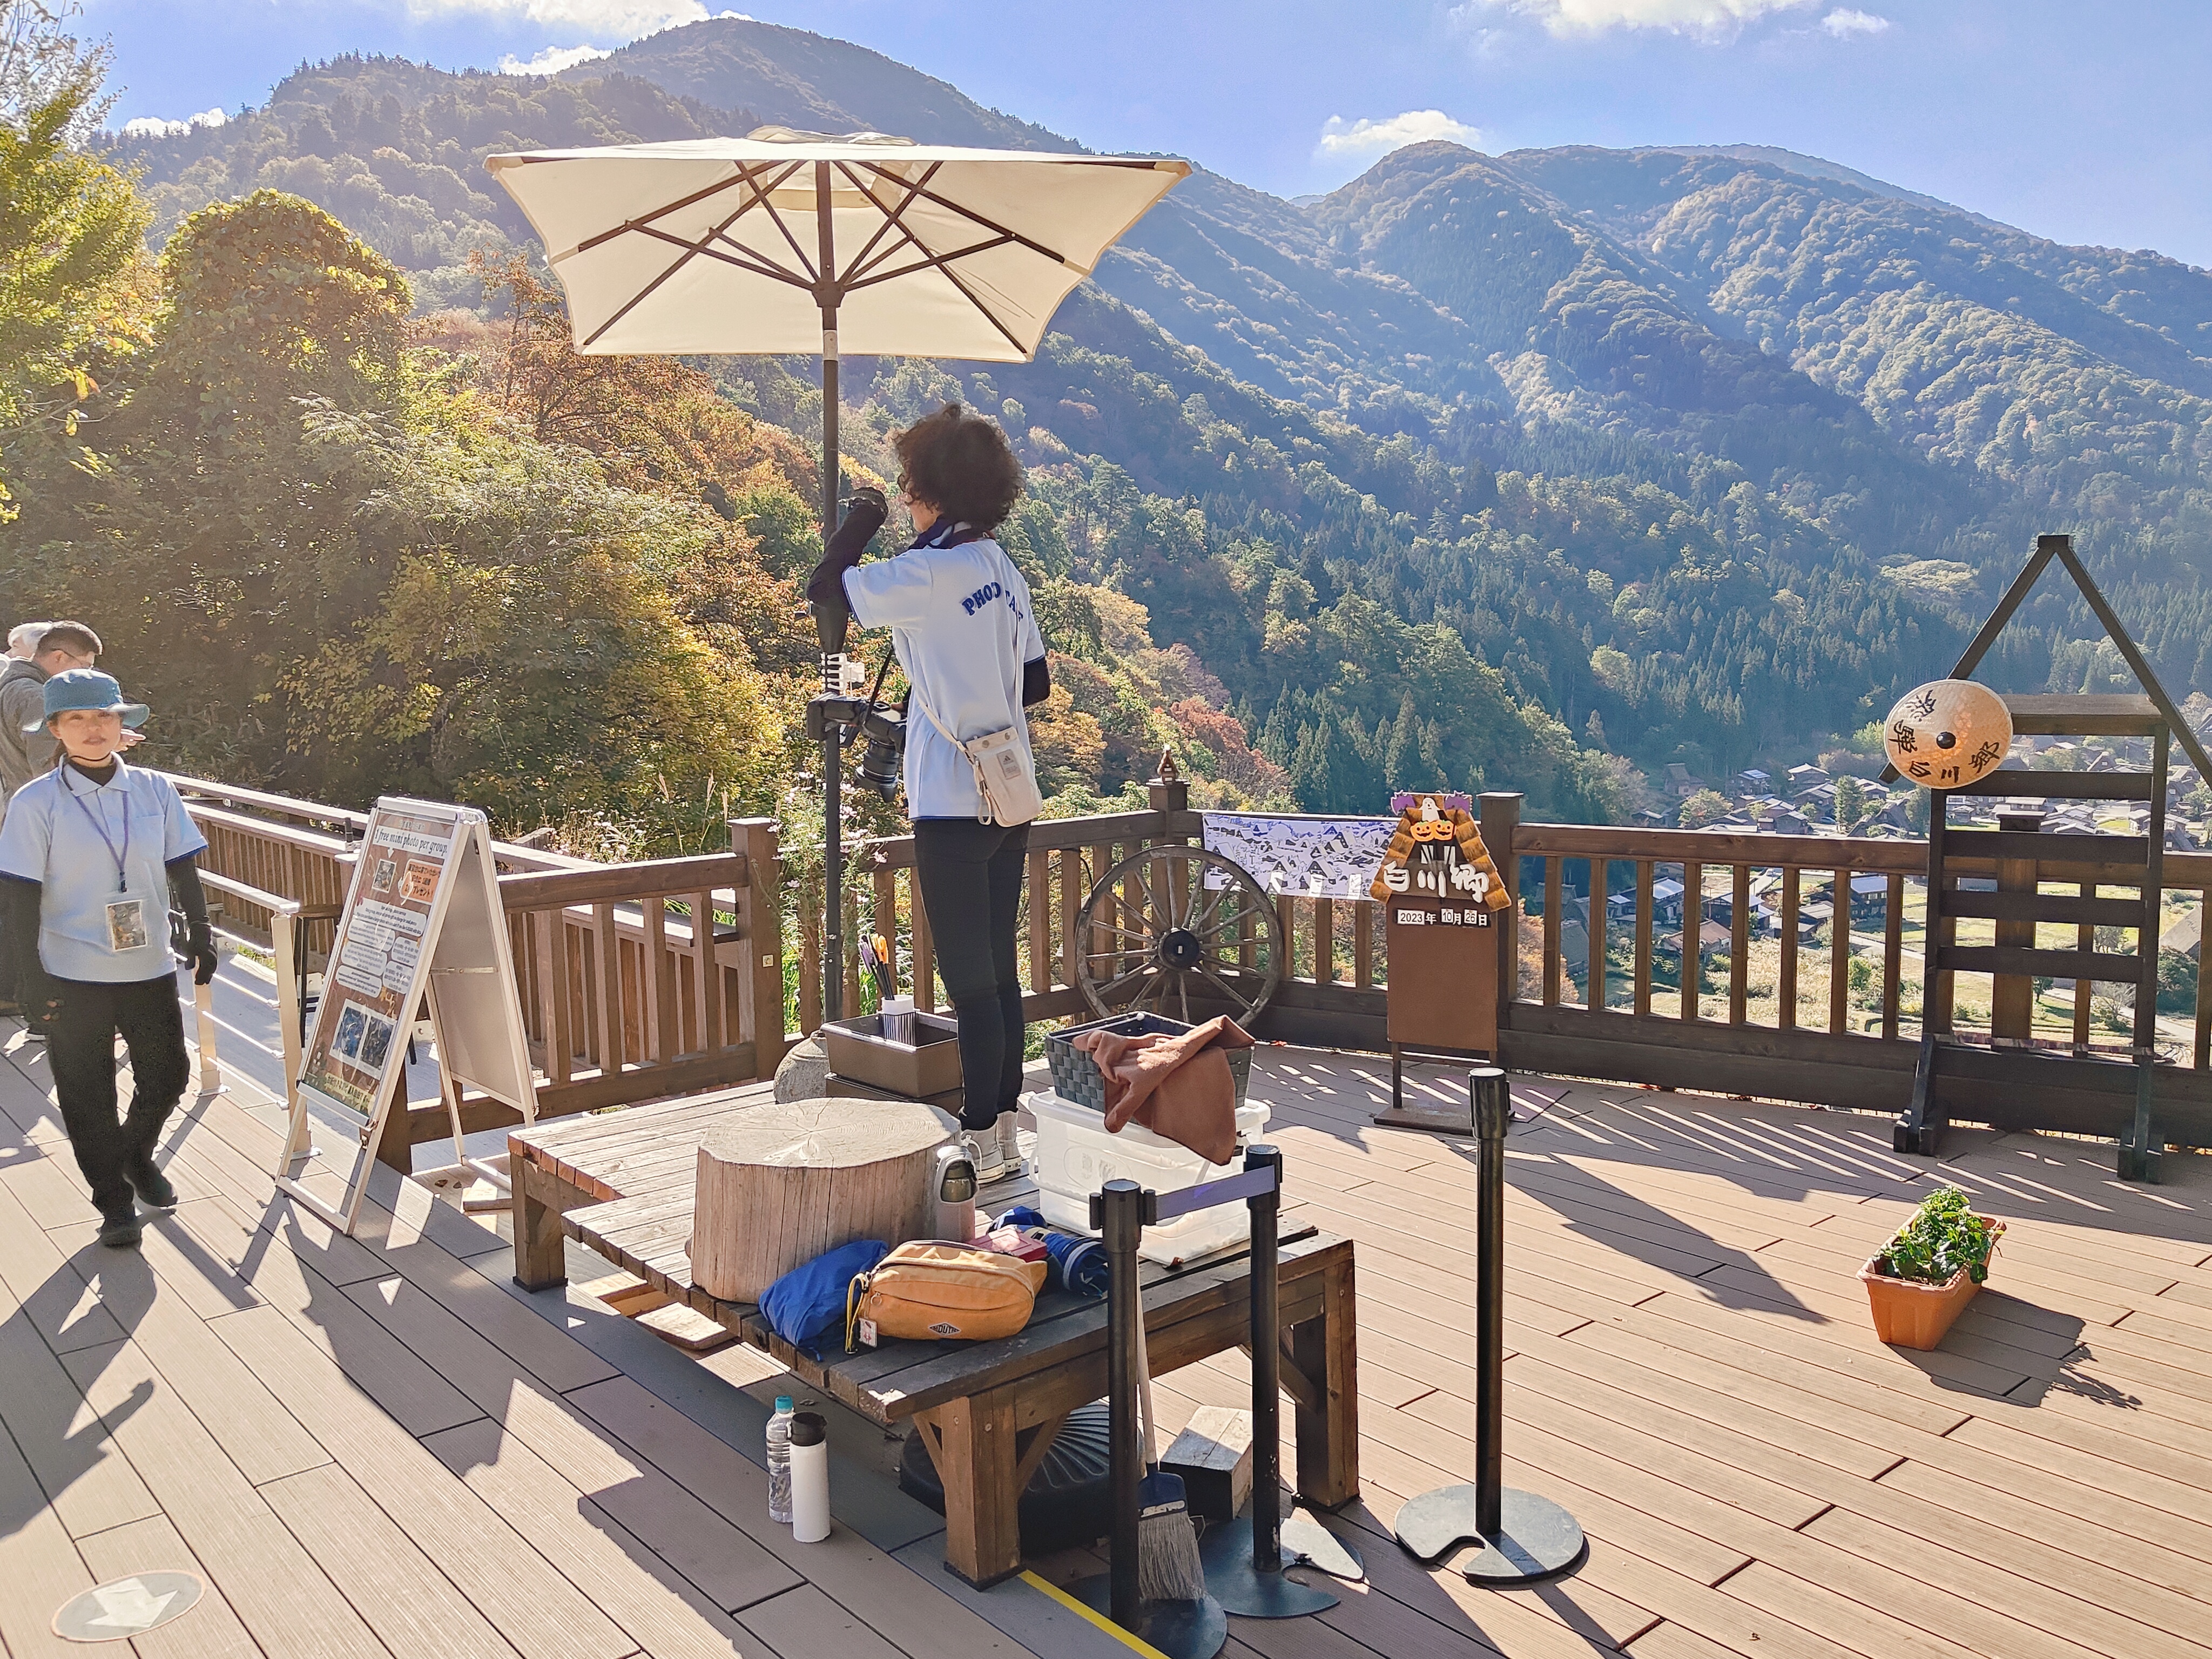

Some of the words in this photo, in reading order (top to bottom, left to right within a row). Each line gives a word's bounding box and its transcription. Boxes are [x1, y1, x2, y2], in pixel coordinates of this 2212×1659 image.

[376, 829, 389, 843] free
[389, 833, 403, 844] mini
[402, 833, 419, 848] photo
[419, 840, 430, 852] per
[1384, 860, 1489, 903] 白川郷
